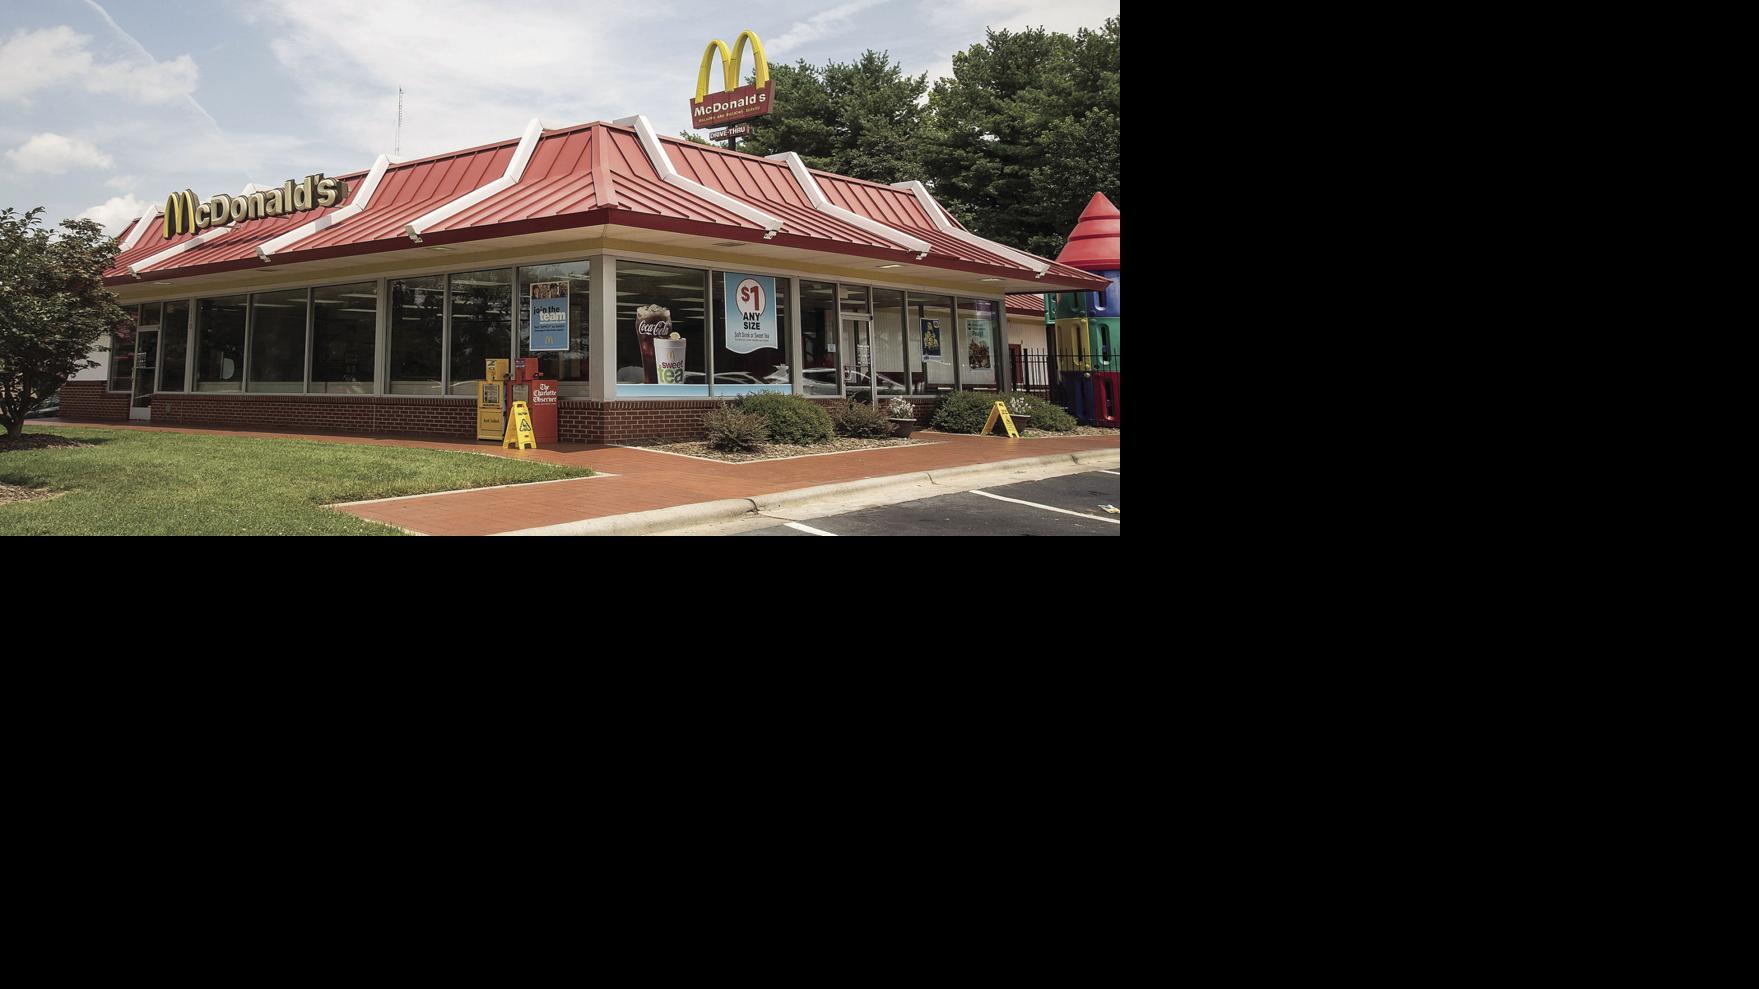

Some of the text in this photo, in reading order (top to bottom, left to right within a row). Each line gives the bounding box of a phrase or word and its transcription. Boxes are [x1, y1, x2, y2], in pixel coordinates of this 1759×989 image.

[694, 93, 766, 117] McDonalds
[710, 126, 746, 138] DRIVE-THRU
[163, 173, 338, 240] McDonald's
[741, 286, 760, 311] $1
[534, 306, 546, 314] join
[540, 310, 566, 320] team
[743, 312, 760, 321] ANY
[639, 320, 669, 336] Coca-Cola
[744, 322, 760, 330] SIZE
[662, 360, 684, 368] sweet
[658, 368, 684, 384] tea
